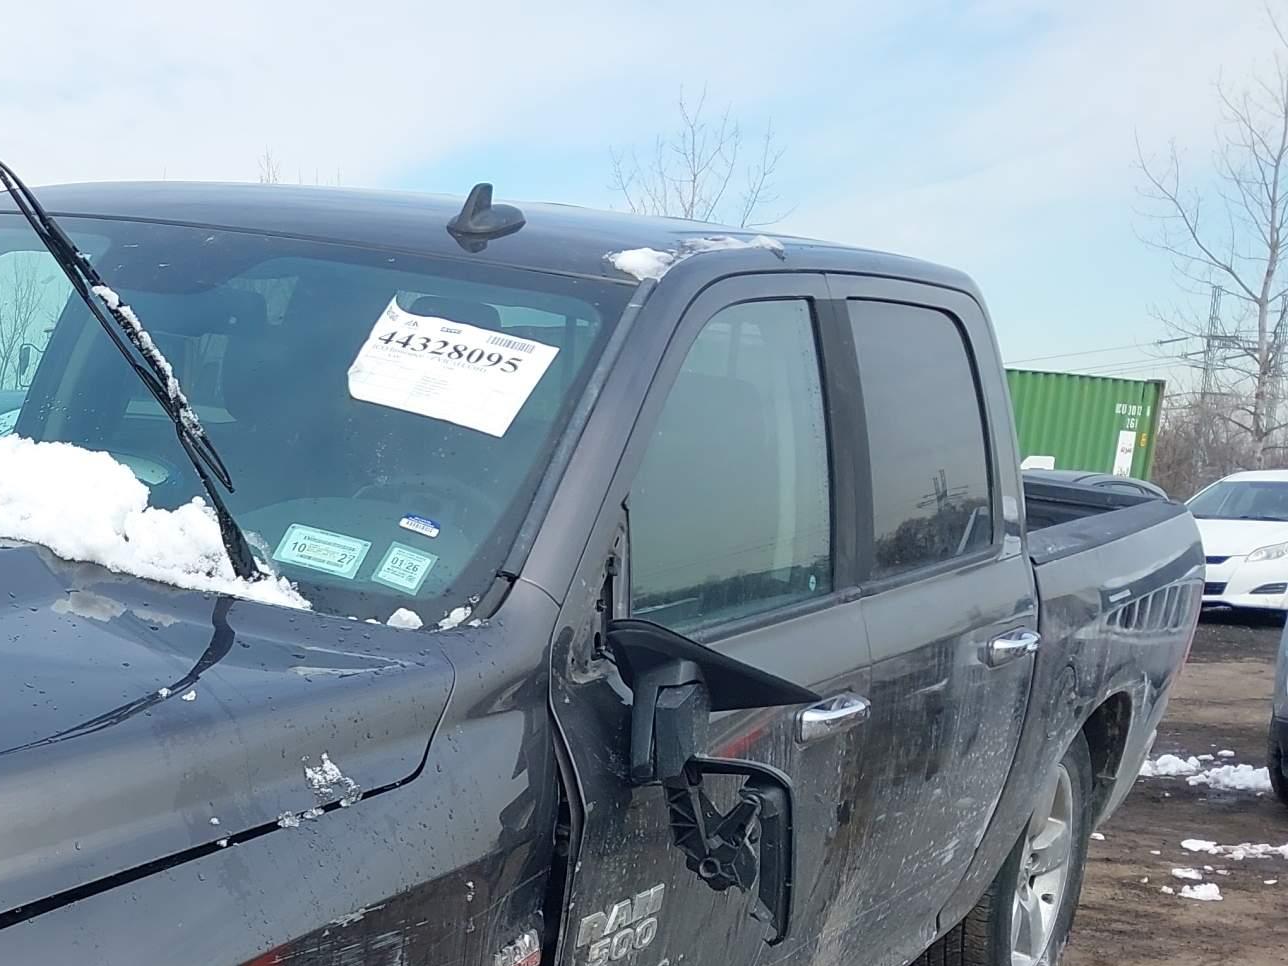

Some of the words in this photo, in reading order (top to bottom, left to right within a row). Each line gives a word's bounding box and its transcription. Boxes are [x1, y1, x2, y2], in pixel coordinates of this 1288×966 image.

[378, 331, 523, 373] 44328095
[291, 541, 307, 553] 10
[337, 553, 357, 565] 27
[577, 882, 665, 947] RAM
